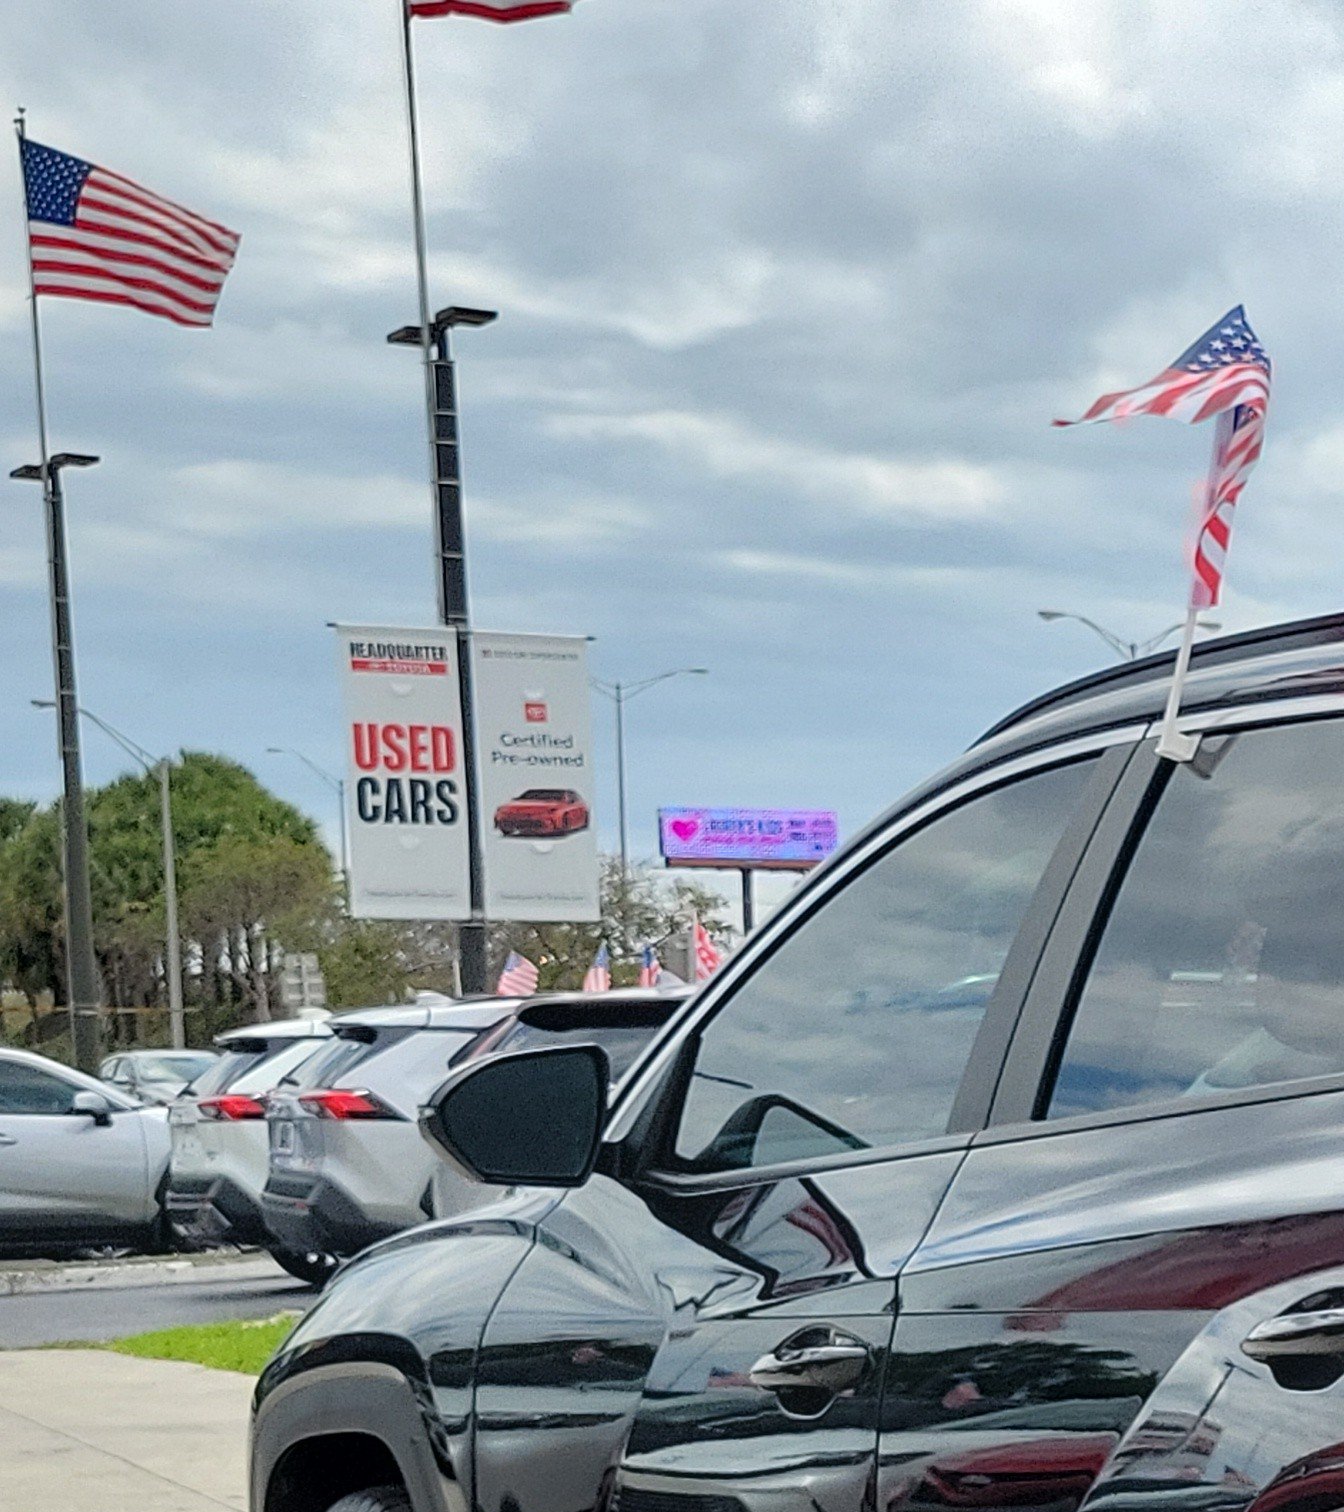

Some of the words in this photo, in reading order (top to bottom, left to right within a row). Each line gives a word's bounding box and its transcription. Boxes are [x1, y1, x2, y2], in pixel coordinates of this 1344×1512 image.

[350, 641, 448, 661] HEADQUARTER
[353, 723, 457, 773] USED
[500, 734, 574, 749] Certified
[491, 751, 585, 767] Pre-owned
[357, 777, 459, 826] CARS
